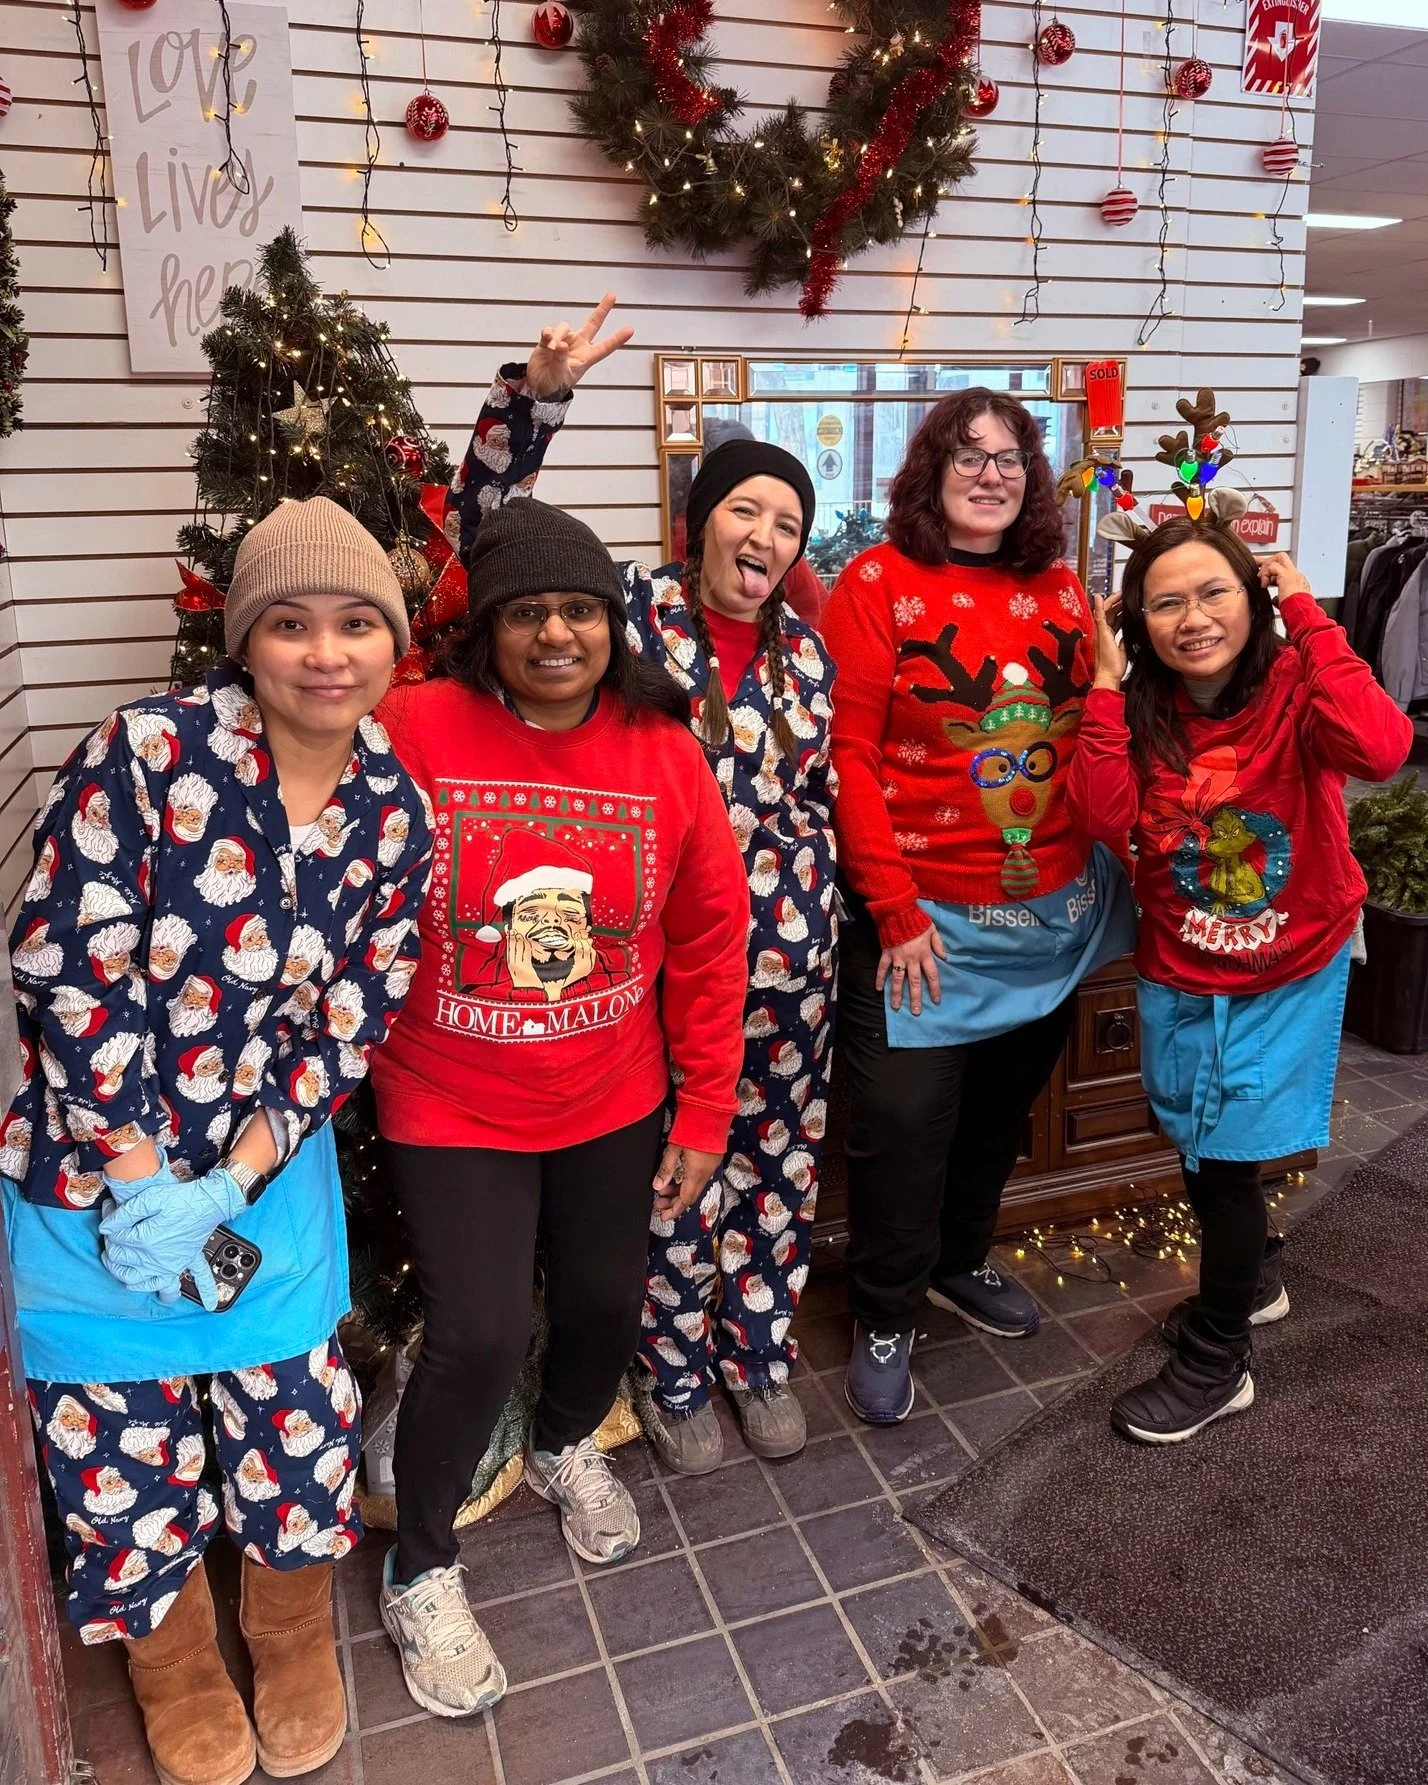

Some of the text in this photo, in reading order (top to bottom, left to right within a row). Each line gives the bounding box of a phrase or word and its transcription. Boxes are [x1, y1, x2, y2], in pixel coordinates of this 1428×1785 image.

[150, 253, 255, 347] her
[1090, 367, 1119, 380] SOLD
[1240, 518, 1275, 537] explain
[1187, 913, 1274, 946] MERRY
[221, 974, 259, 995] Old Navy
[434, 997, 521, 1037] HOME
[90, 1515, 109, 1525] Old
[108, 1596, 148, 1615] Old Navy
